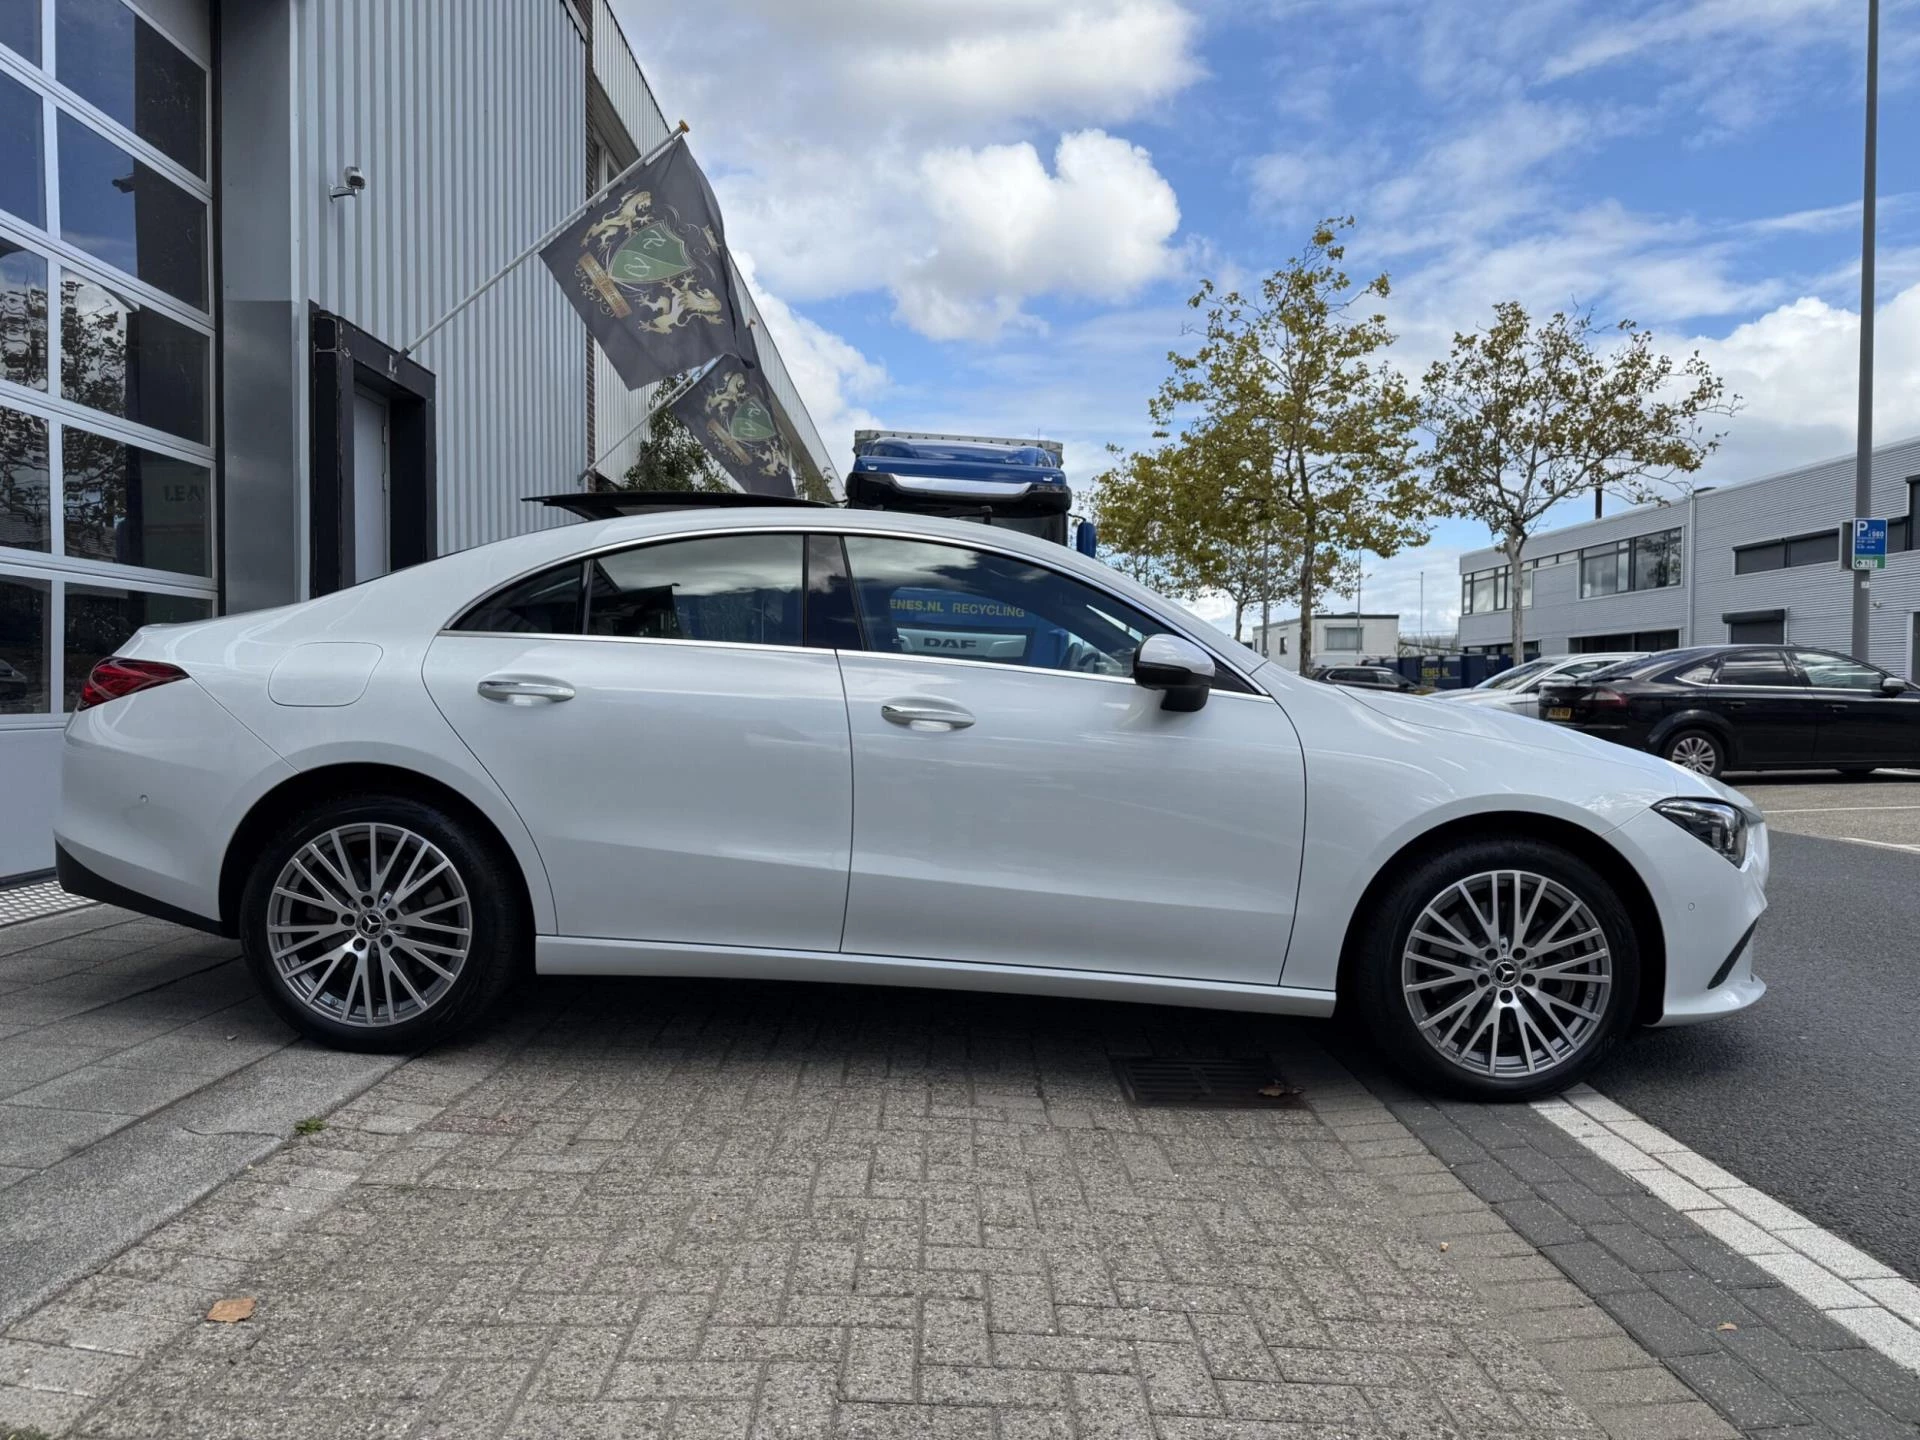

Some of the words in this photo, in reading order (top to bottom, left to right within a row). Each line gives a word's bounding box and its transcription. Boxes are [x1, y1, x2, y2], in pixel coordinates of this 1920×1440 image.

[1856, 521, 1868, 537] P
[953, 602, 1025, 618] RECYCLING
[924, 637, 977, 649] DAF
